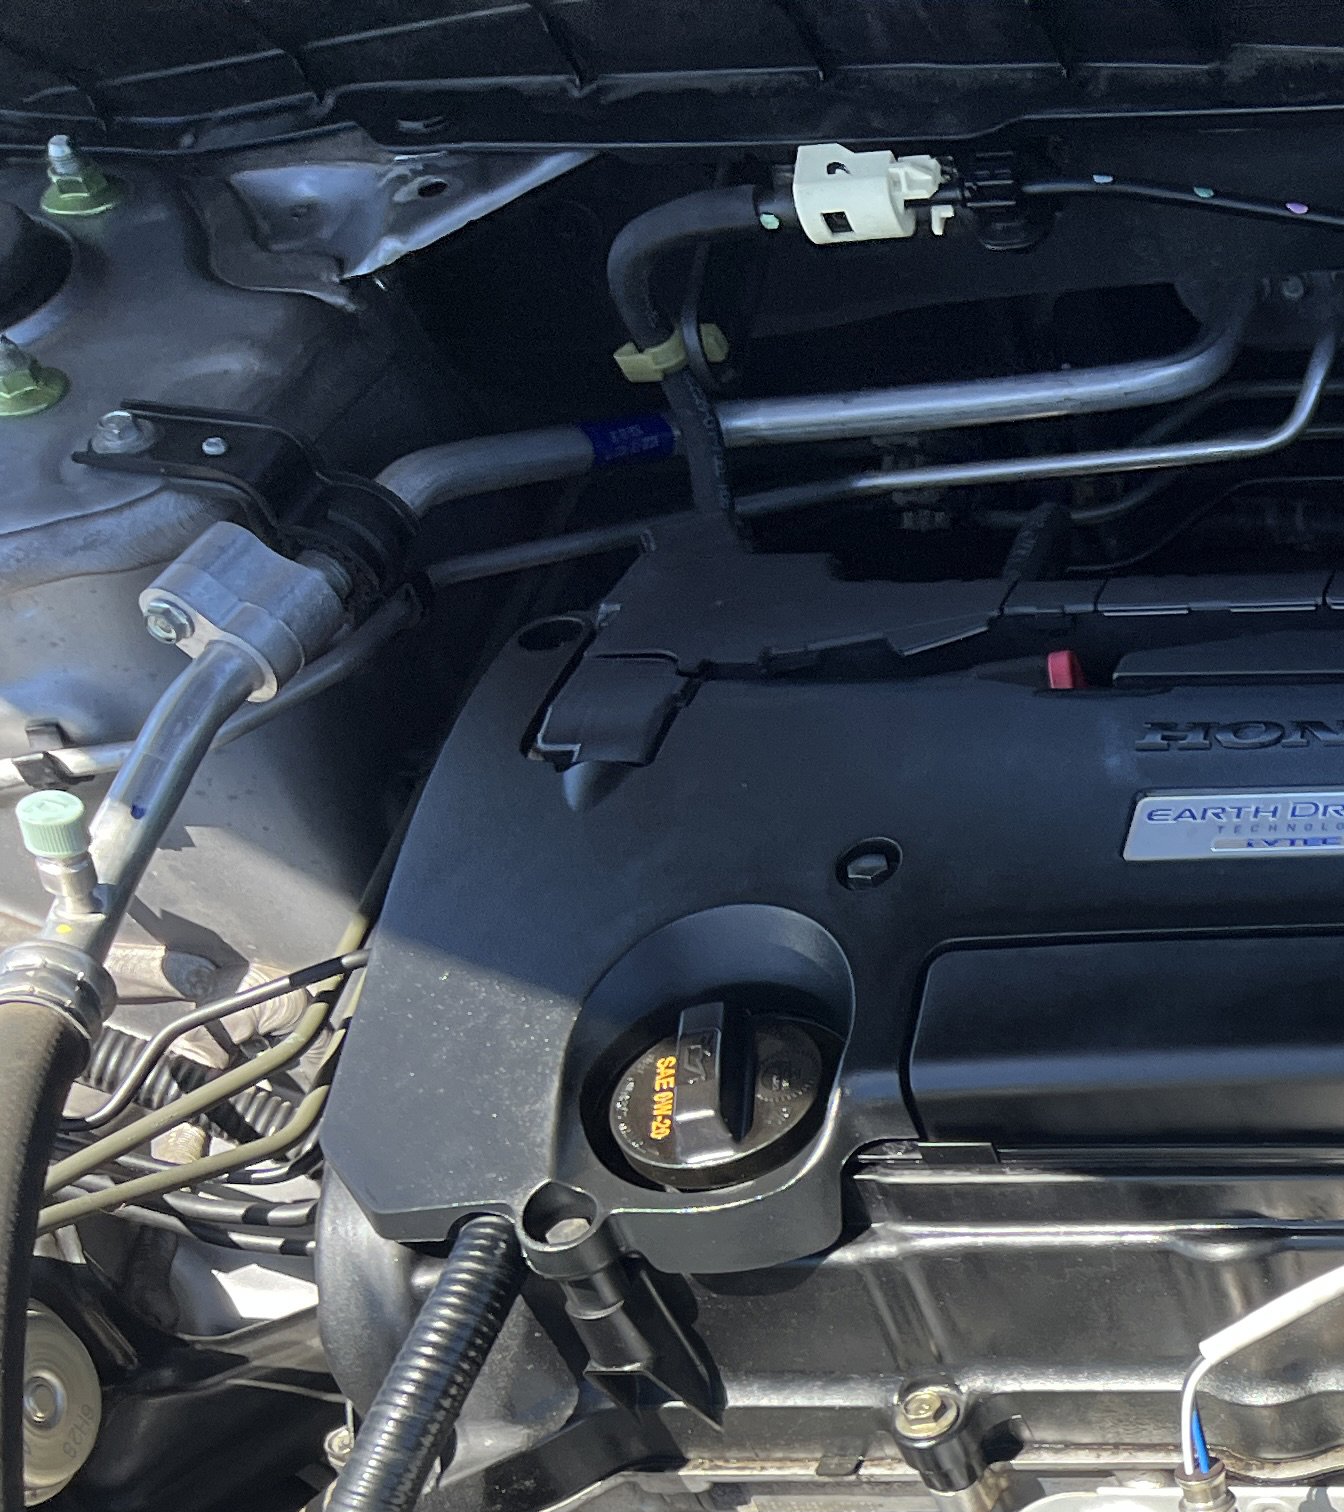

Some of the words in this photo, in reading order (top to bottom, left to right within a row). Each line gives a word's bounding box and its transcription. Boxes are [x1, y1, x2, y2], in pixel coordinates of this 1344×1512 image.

[1147, 806, 1278, 824] EARTH
[654, 1056, 677, 1091] SAE
[650, 1091, 675, 1140] 0W-20
